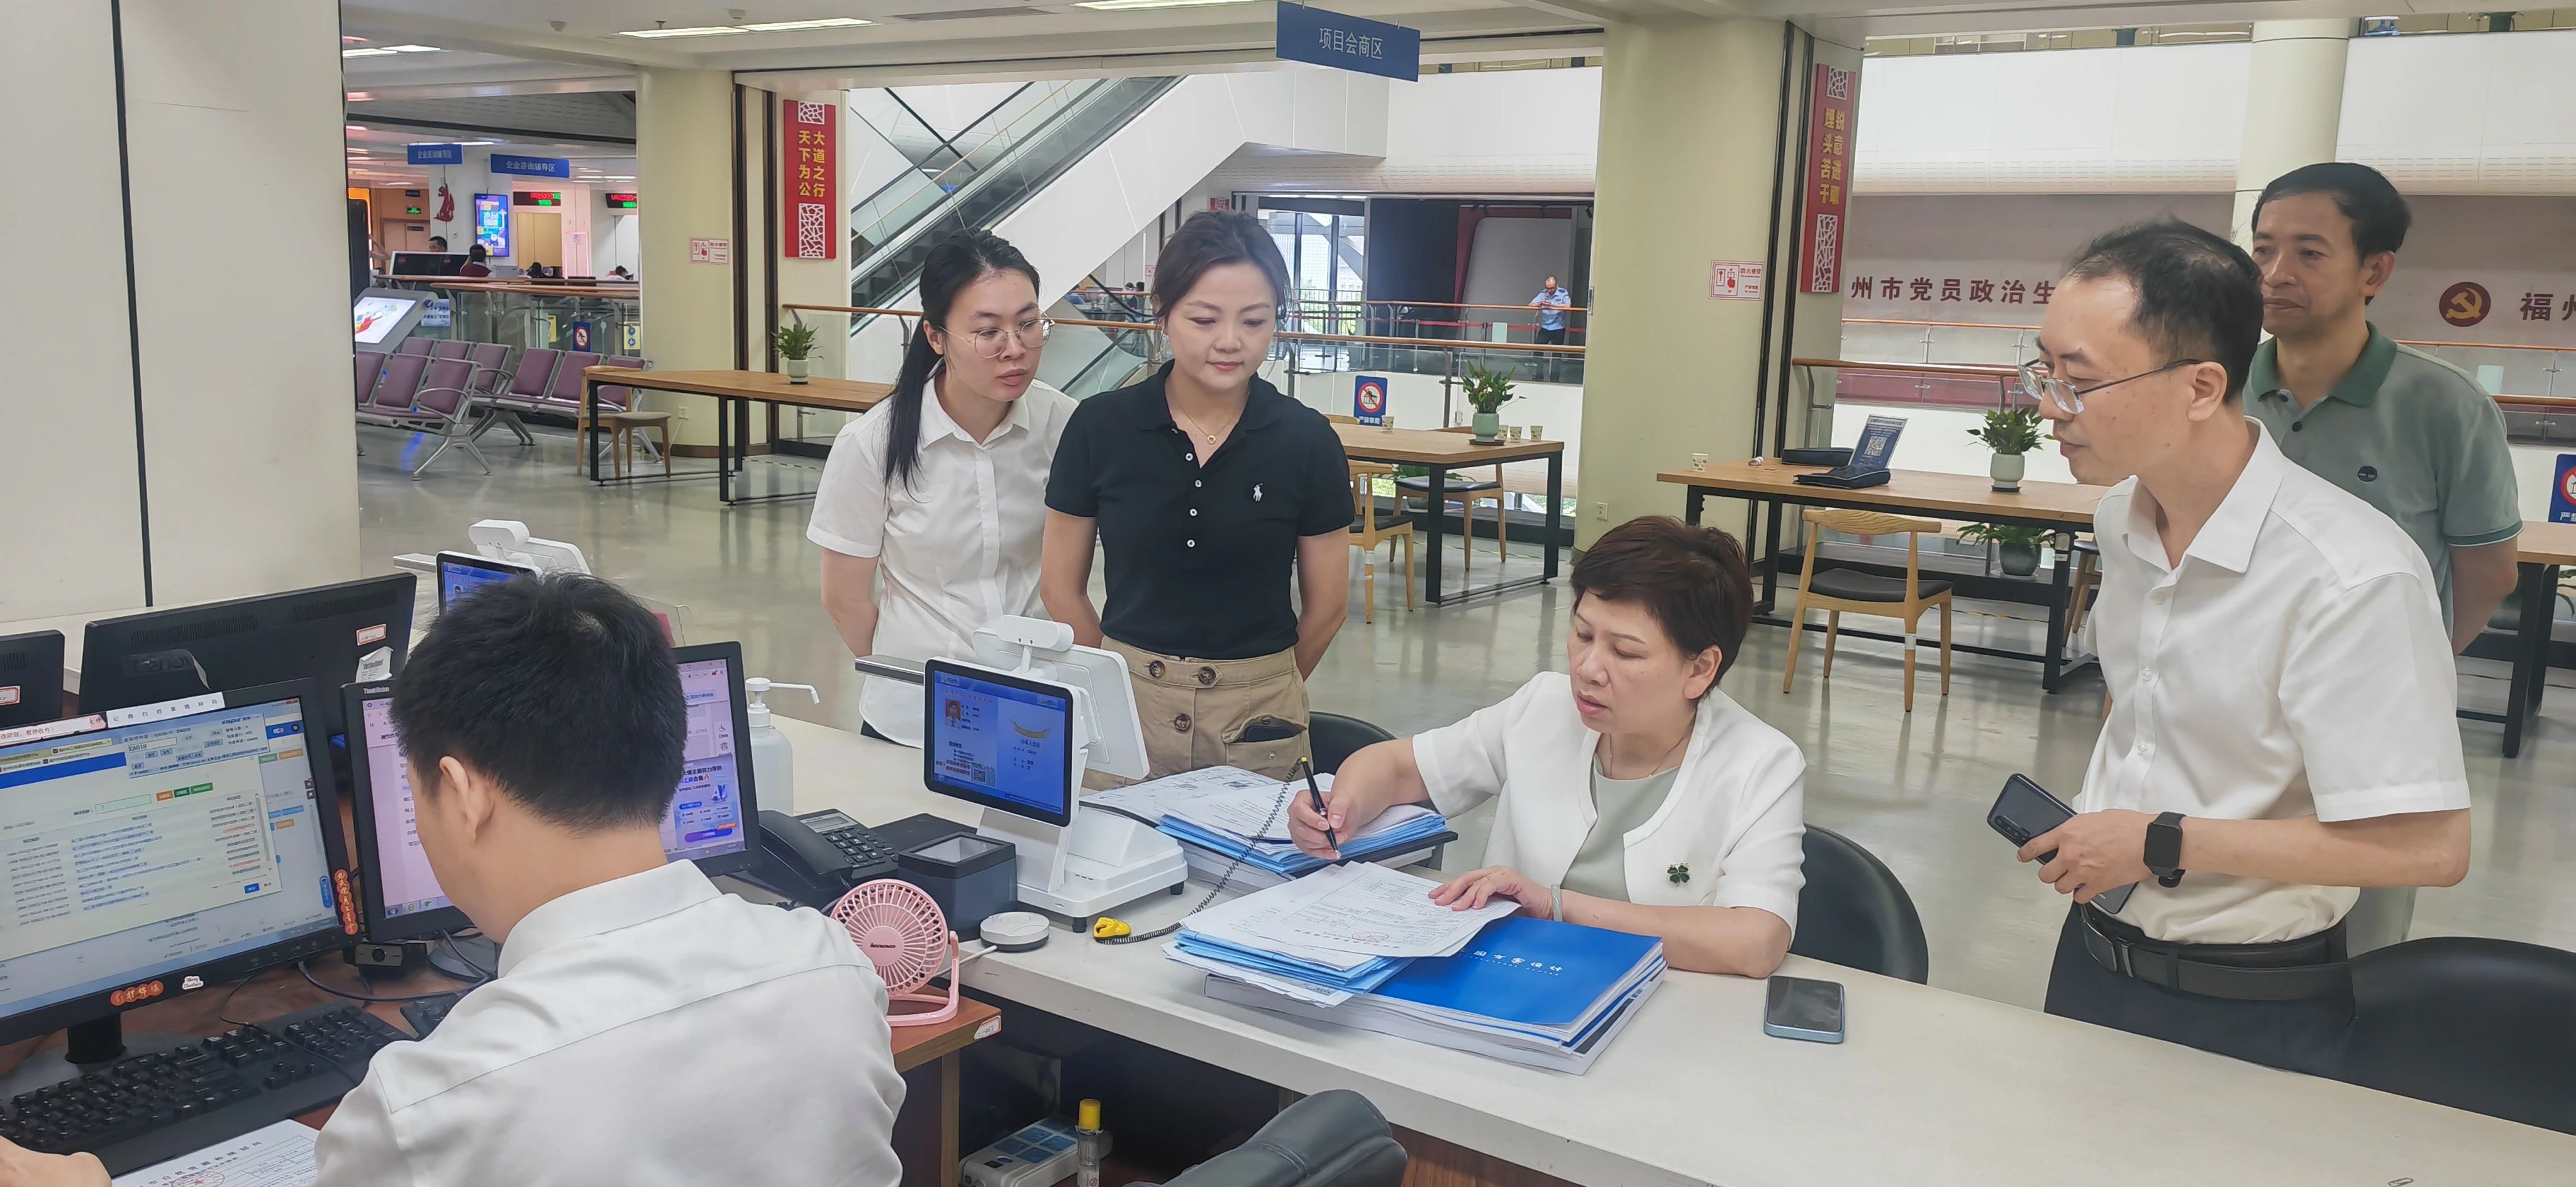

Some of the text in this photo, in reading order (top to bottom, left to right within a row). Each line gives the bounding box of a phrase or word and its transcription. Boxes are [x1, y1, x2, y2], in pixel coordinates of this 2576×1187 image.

[1318, 28, 1383, 59] 项目会商区
[506, 161, 555, 172] 企业咨询辅导区
[798, 130, 811, 196] 天下为公
[813, 131, 825, 197] 大道之行
[1819, 108, 1835, 204] 埋头苦干
